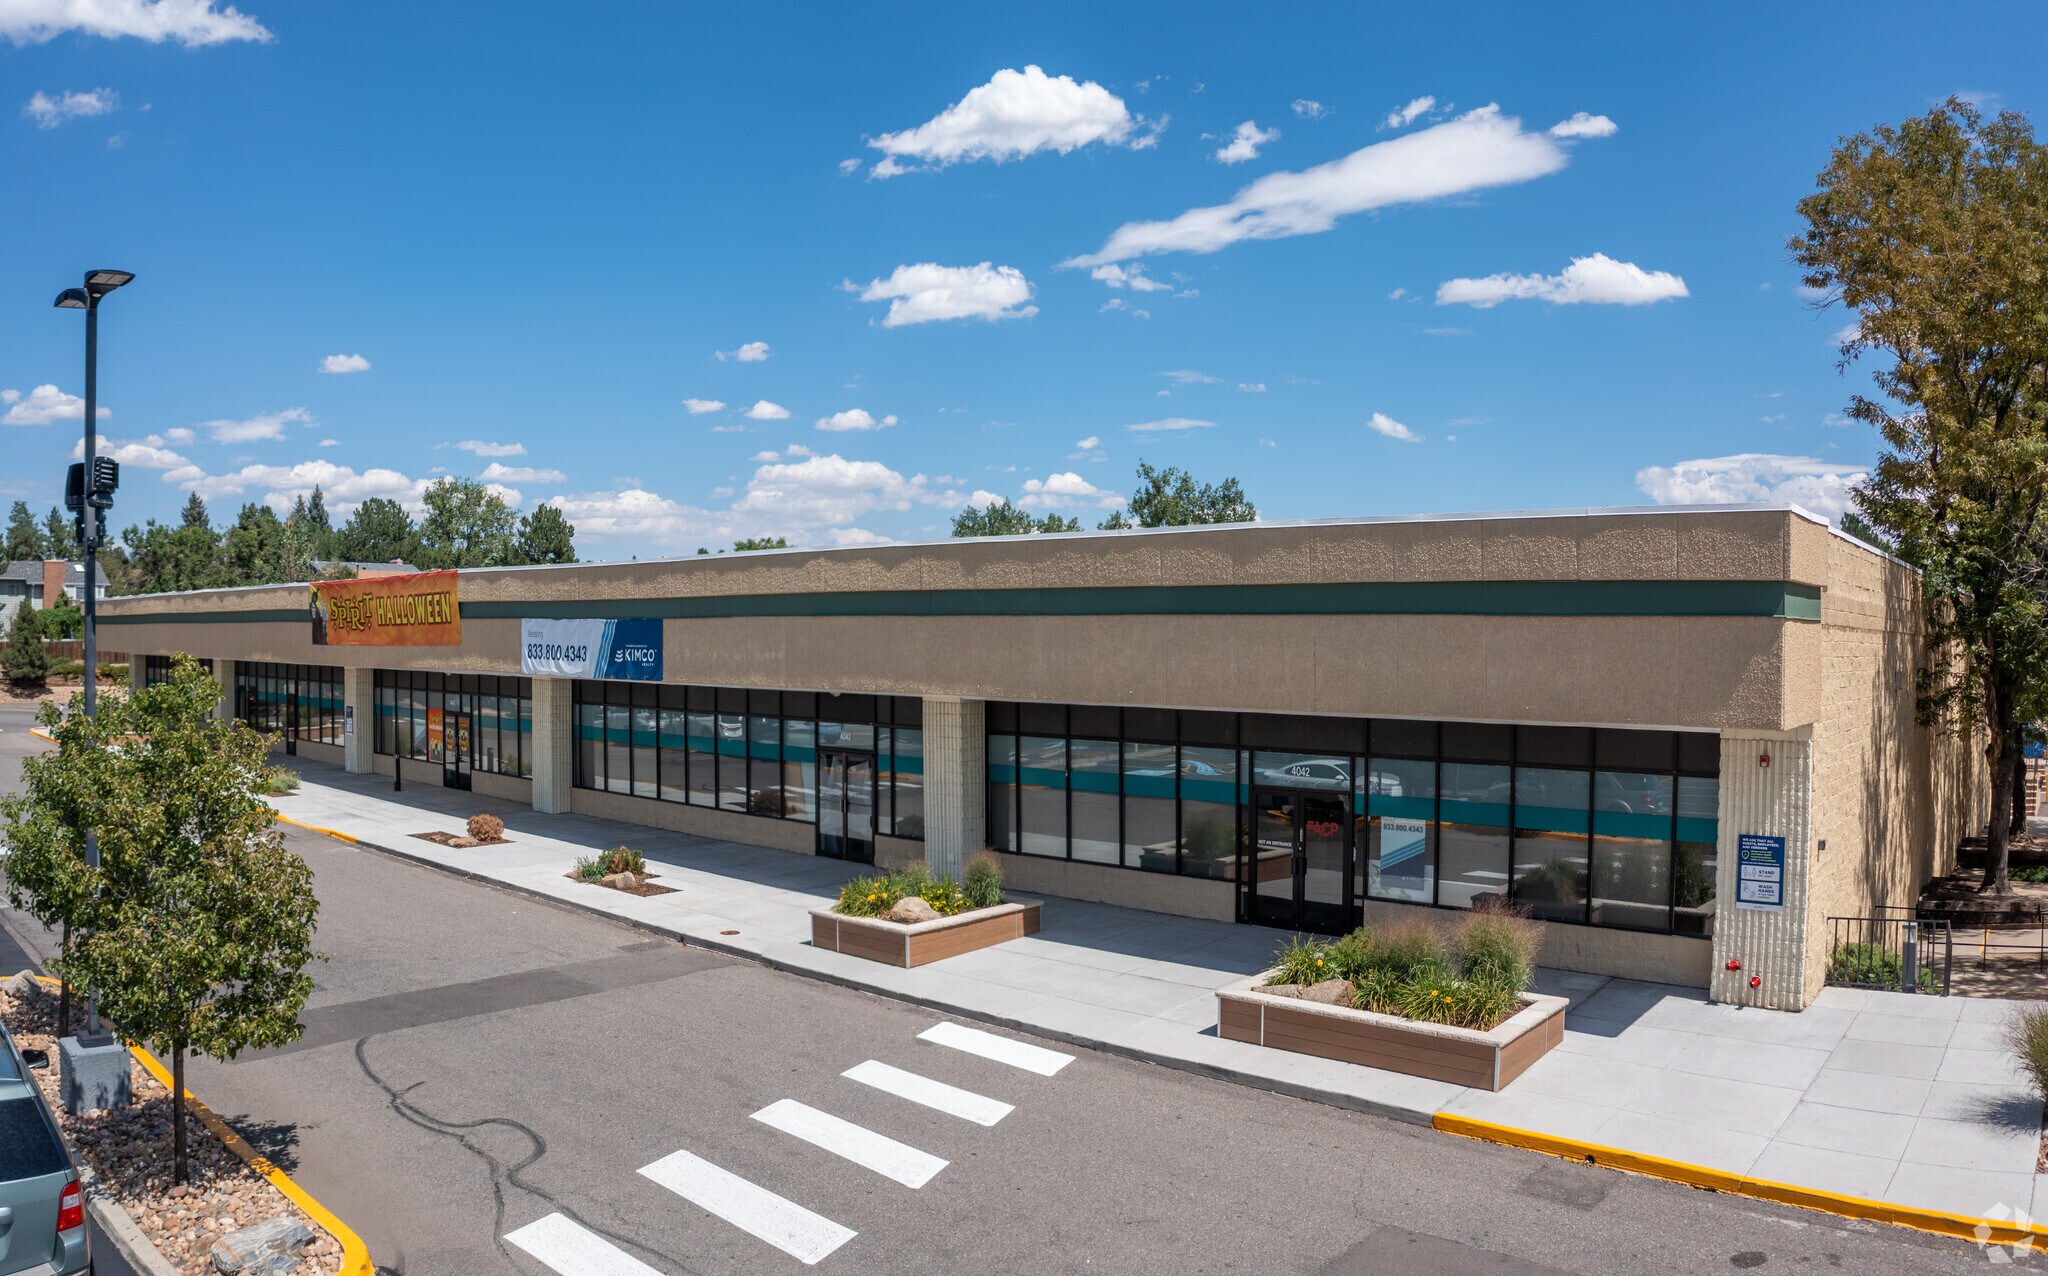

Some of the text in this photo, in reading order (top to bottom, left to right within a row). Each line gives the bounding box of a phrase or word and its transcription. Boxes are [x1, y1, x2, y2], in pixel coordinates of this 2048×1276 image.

[330, 592, 452, 631] SPIRIT HALLOWEEN
[527, 629, 544, 640] leasing
[527, 643, 587, 662] 833.800.4343
[624, 648, 655, 662] KIMCO
[1291, 766, 1310, 777] 4042
[1306, 820, 1339, 837] FACP
[1383, 823, 1424, 833] 833.800.4343
